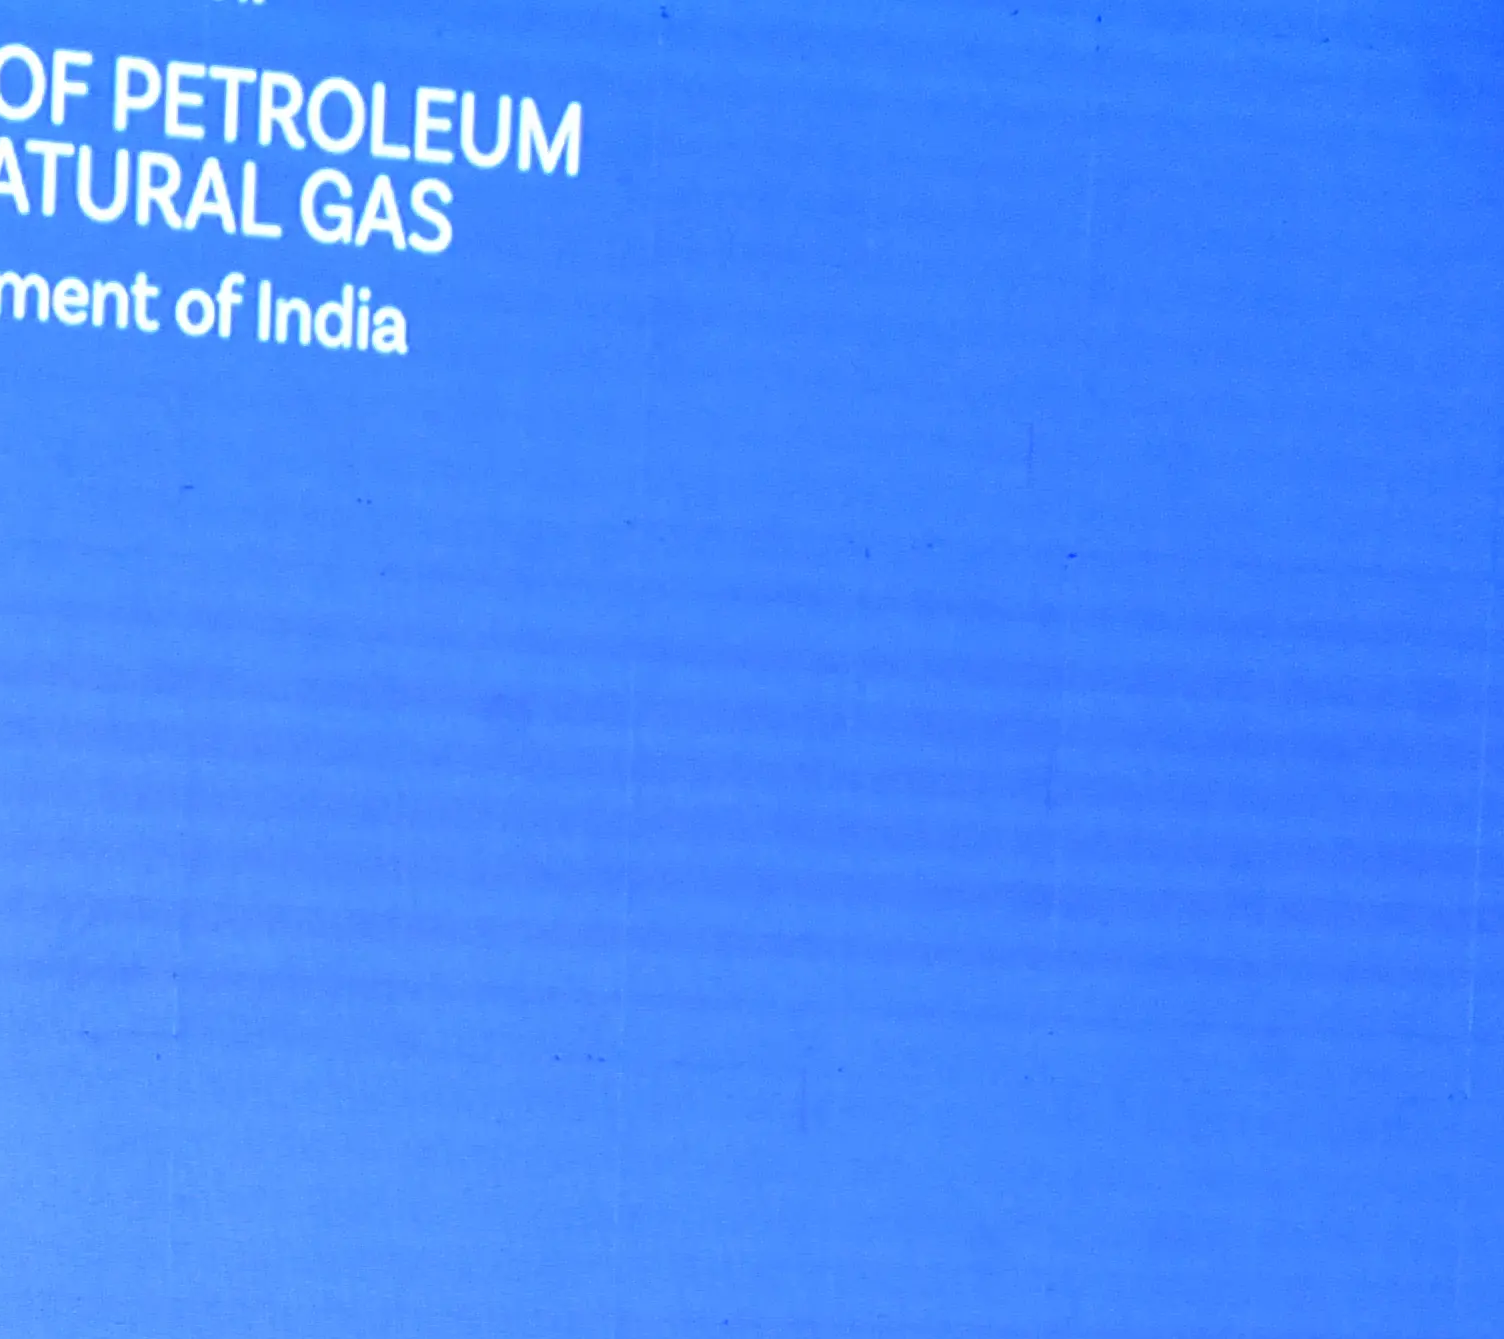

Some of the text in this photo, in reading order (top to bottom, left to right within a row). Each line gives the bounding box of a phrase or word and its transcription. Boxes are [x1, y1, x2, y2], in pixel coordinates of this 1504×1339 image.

[115, 57, 582, 175] PETROLEUM
[301, 169, 453, 252] GAS
[176, 272, 245, 337] of
[258, 281, 408, 353] India
